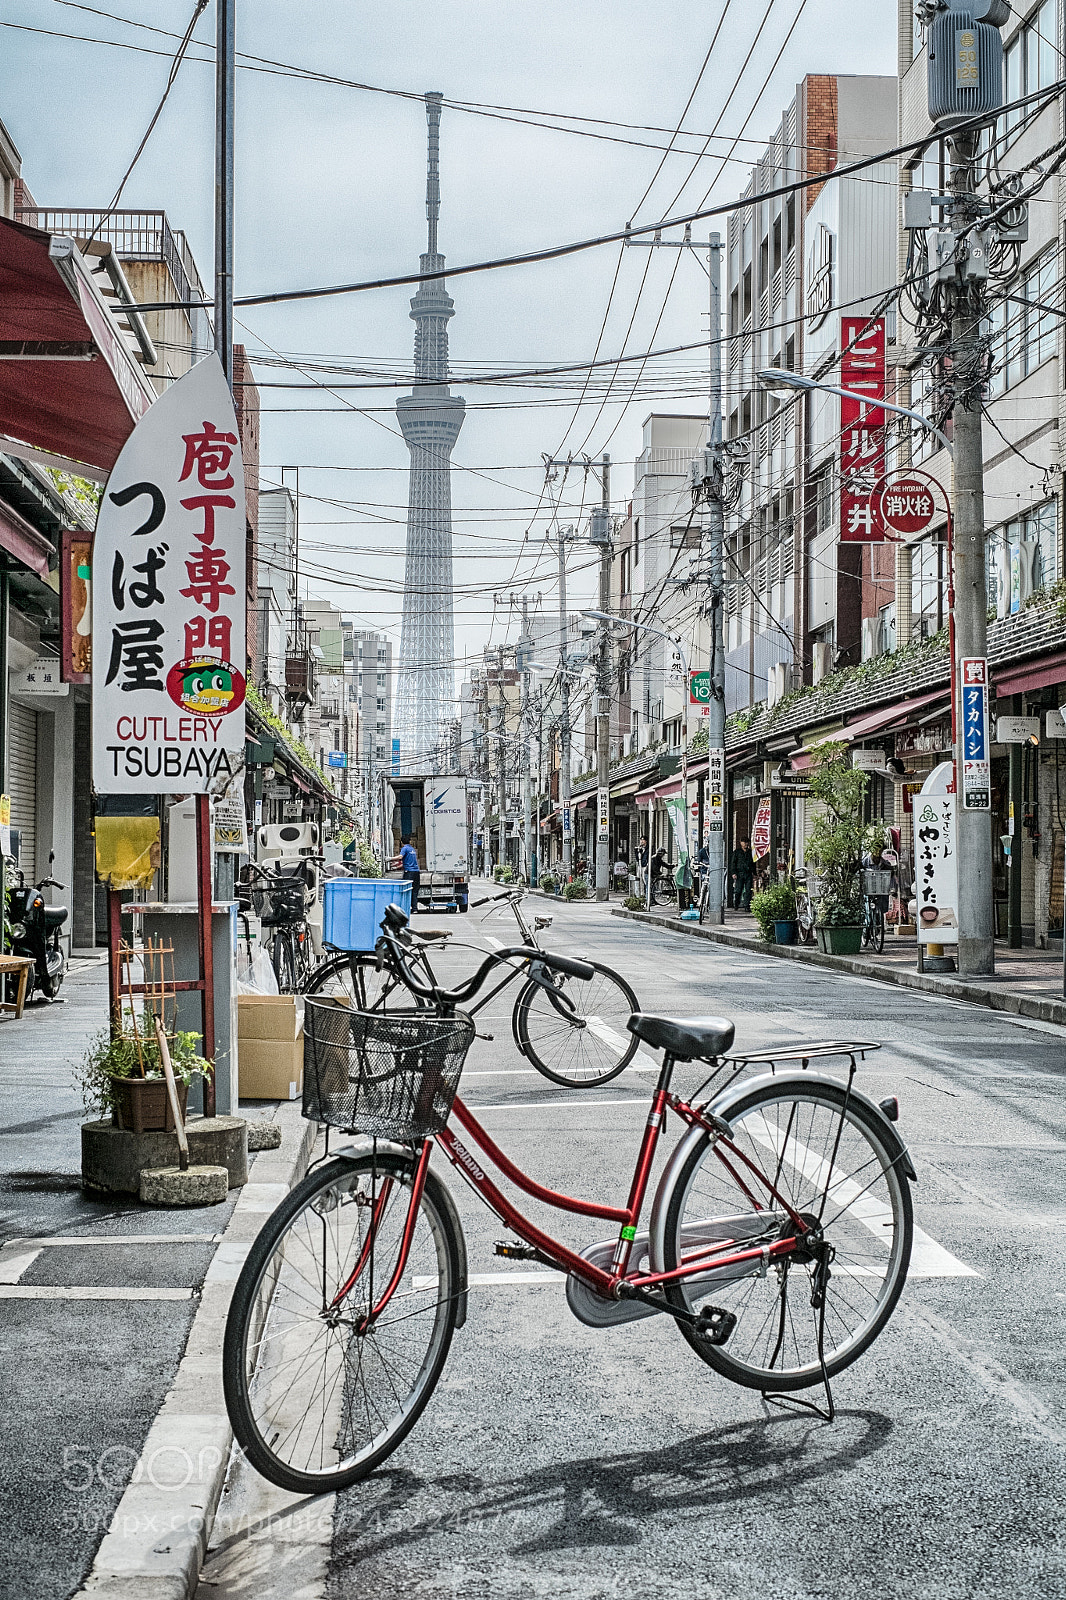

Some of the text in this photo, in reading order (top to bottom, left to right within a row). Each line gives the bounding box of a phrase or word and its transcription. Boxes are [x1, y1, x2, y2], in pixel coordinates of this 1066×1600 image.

[959, 50, 976, 63] 50
[957, 67, 978, 79] 125
[847, 324, 882, 534] ビニール岩井
[886, 494, 932, 517] 消火栓
[177, 421, 239, 662] 庖丁専門
[104, 481, 170, 692] つば屋
[966, 662, 984, 682] 質
[180, 692, 230, 707] 組合加盟店
[116, 716, 223, 742] CUTLERY
[967, 690, 982, 757] タカハシ
[106, 746, 232, 778] TSUBAYA
[711, 758, 722, 793] 時間貸
[711, 795, 721, 807] P
[918, 825, 941, 904] やぶきた
[449, 1137, 485, 1181] Belluno
